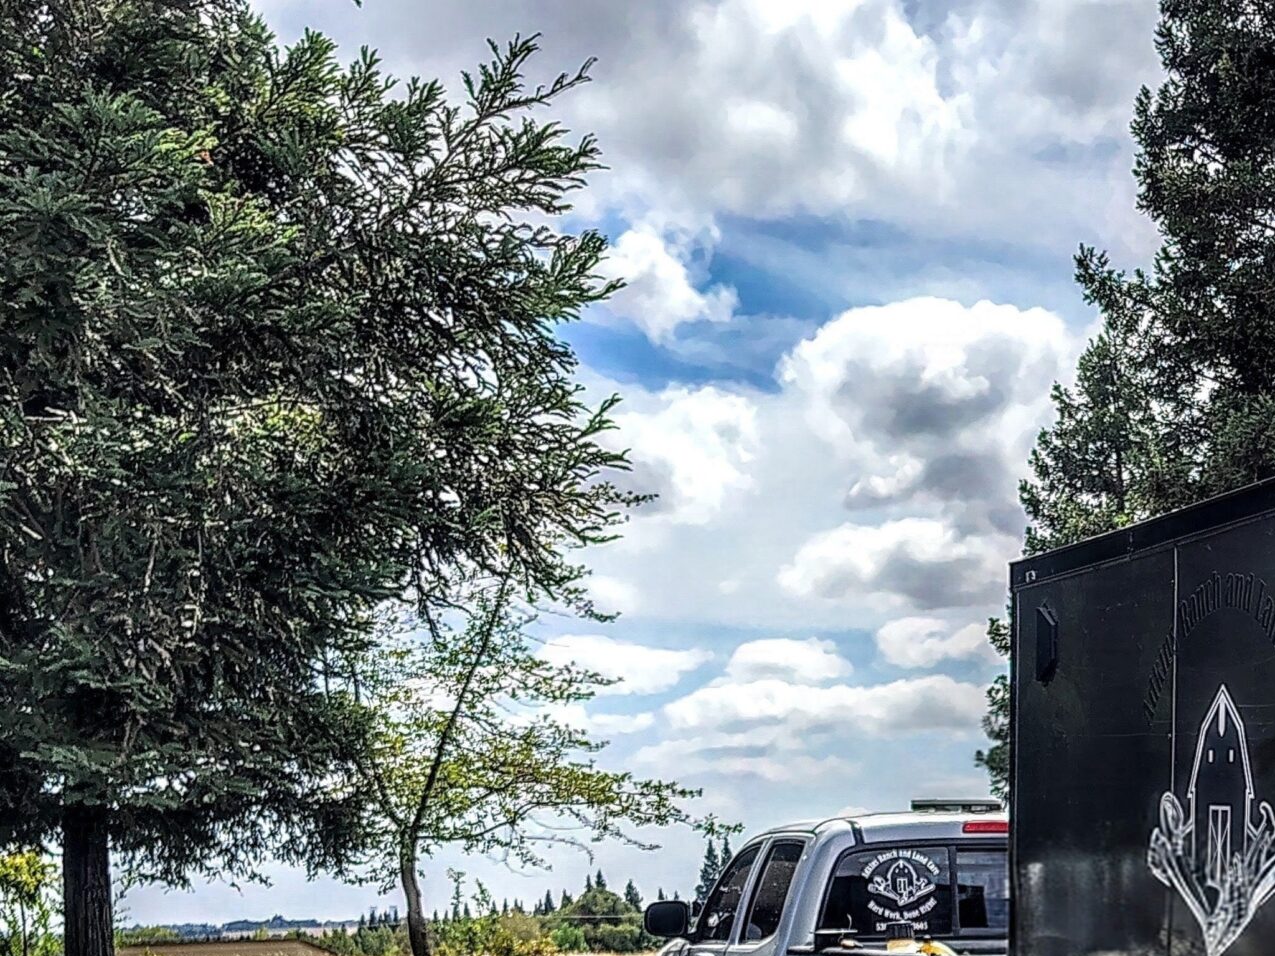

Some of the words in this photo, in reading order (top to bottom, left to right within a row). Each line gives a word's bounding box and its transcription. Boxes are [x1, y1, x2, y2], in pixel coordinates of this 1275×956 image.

[1178, 570, 1222, 638] Ranch
[1224, 571, 1255, 613] and
[898, 849, 911, 859] and
